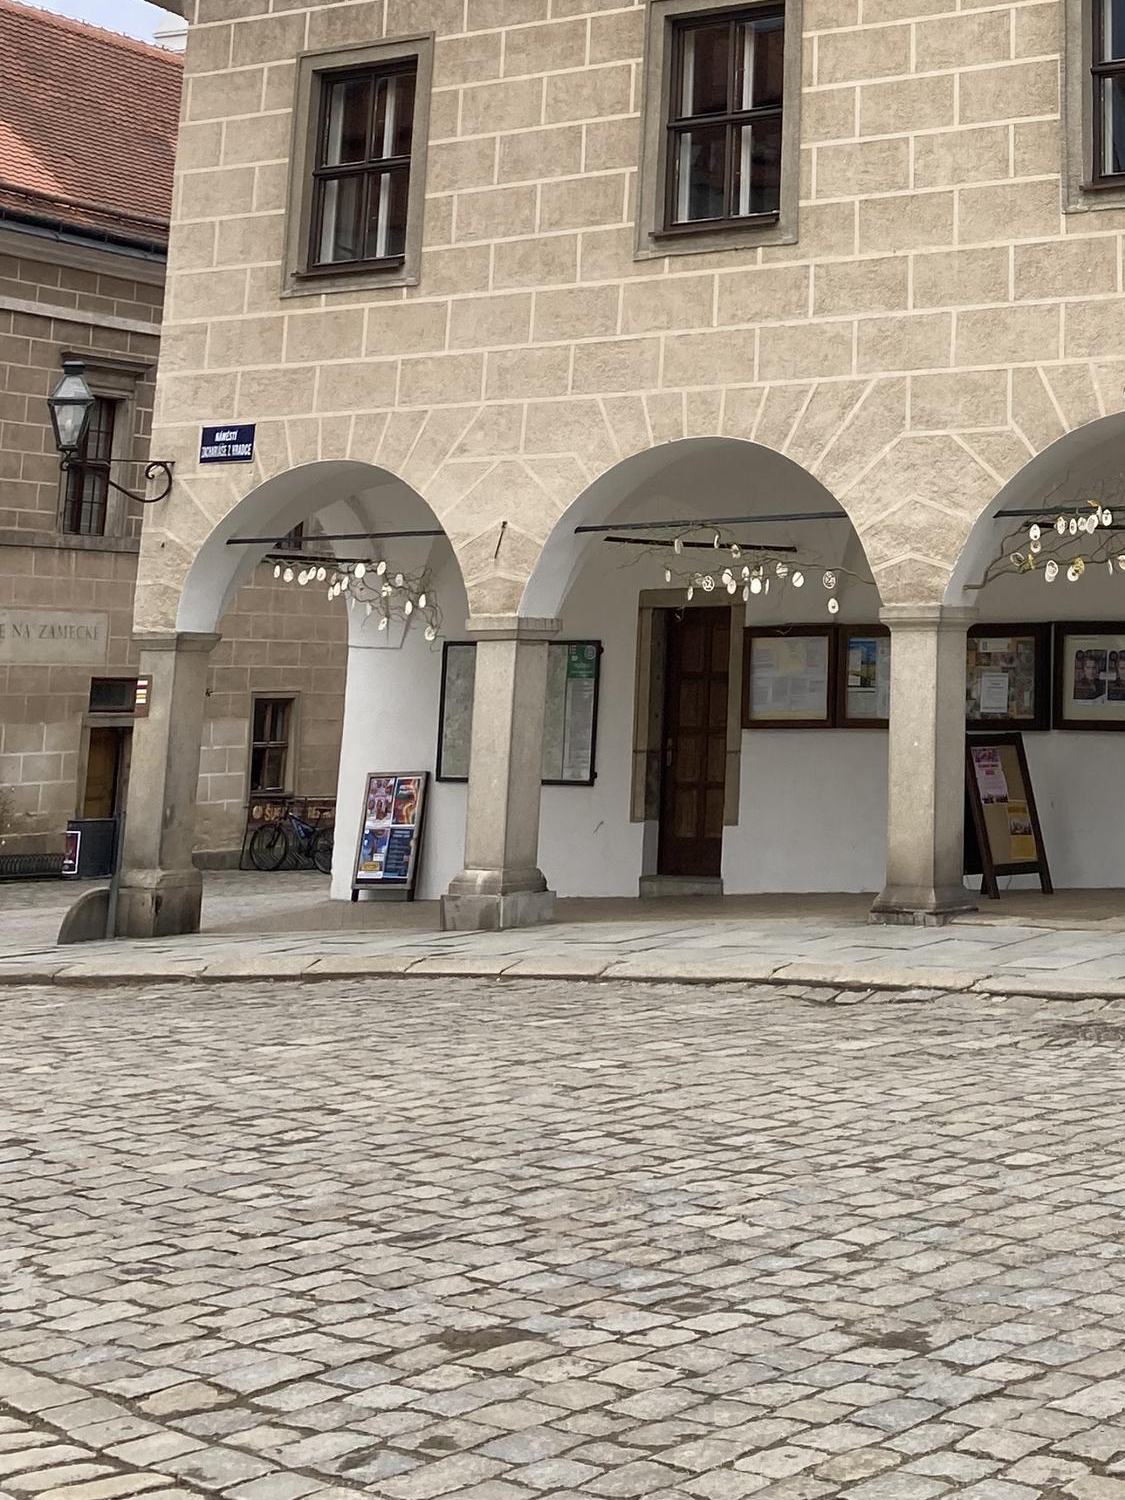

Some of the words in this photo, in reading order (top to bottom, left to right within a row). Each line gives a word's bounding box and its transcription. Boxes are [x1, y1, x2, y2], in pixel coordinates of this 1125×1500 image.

[214, 430, 238, 442] NÁMĚSTÍ
[227, 444, 231, 457] Z
[232, 443, 252, 457] HRADCE
